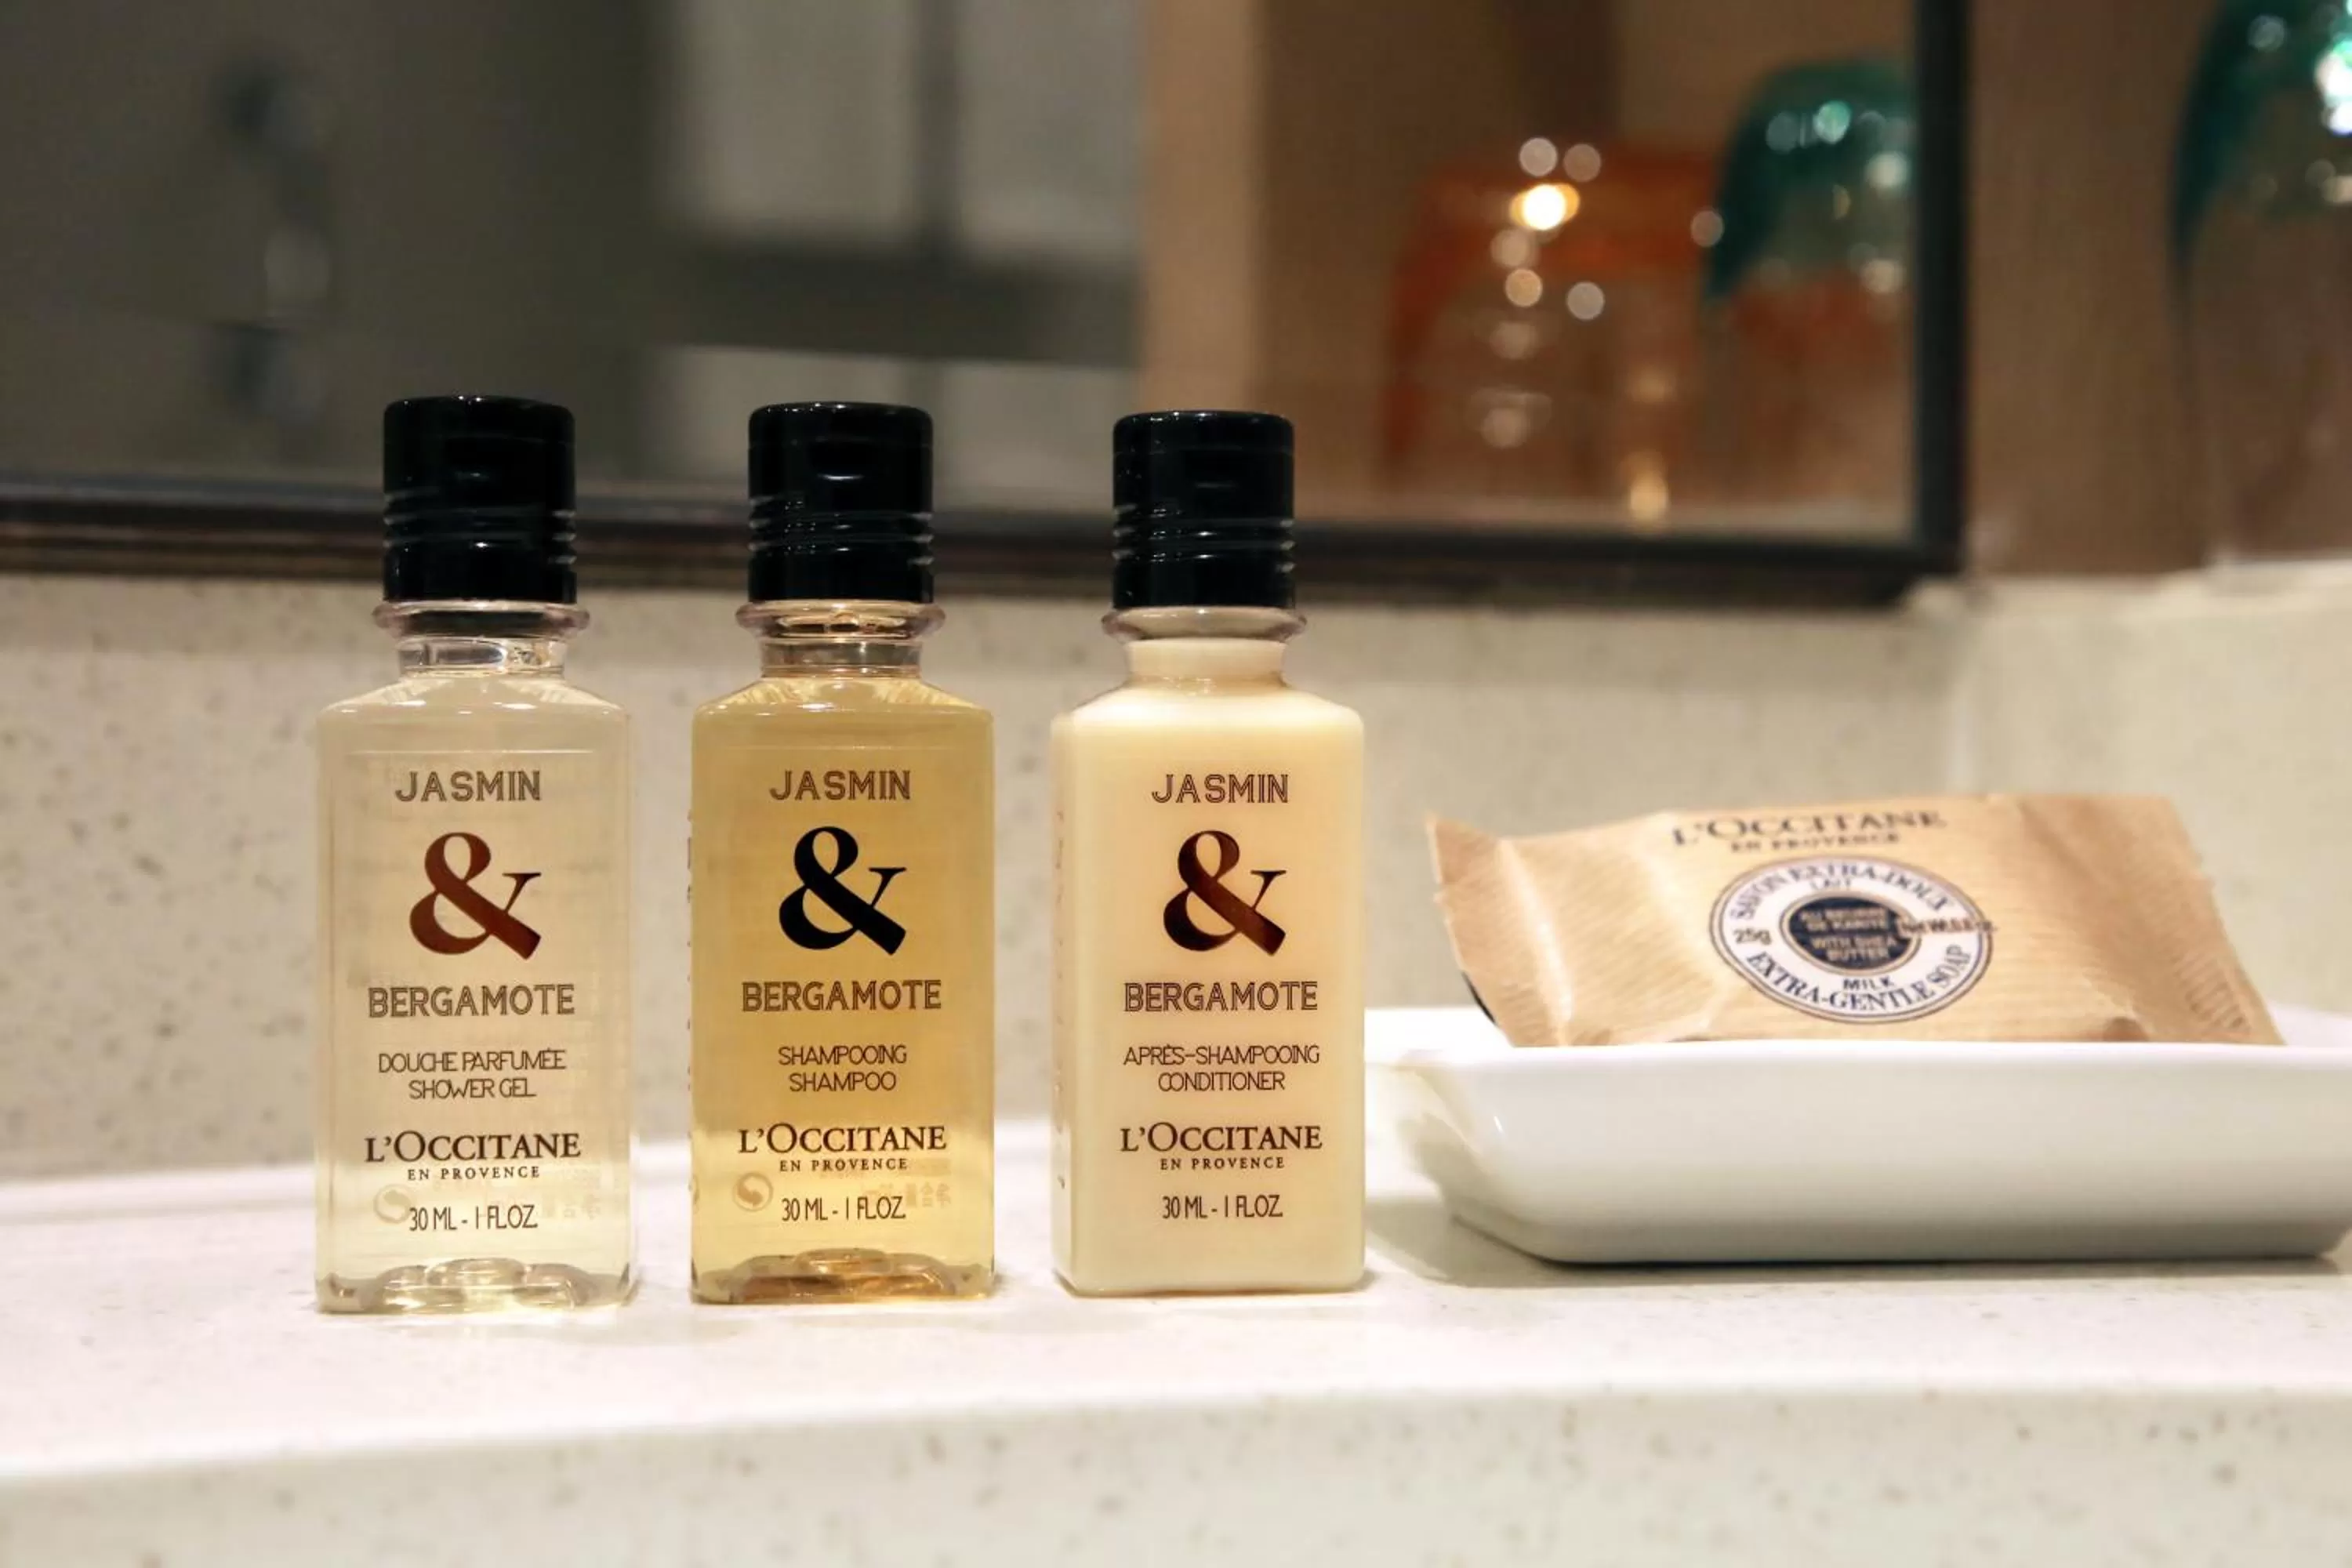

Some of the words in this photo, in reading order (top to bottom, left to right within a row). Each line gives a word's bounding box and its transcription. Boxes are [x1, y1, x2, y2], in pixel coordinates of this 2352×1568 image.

[395, 770, 543, 803] JASMIN
[769, 770, 911, 800] JASMIN
[1152, 773, 1289, 804] JASMIN
[409, 832, 542, 960] &
[778, 826, 907, 956] &
[1163, 829, 1287, 956] &
[742, 979, 942, 1012] BERGAMOTE
[1123, 981, 1319, 1012] BERGAMOTE
[1842, 975, 1895, 990] MILK
[368, 983, 575, 1018] BERGAMOTE
[378, 1051, 457, 1073] DOUCHE
[462, 1047, 568, 1071] PARFUMÉE
[778, 1044, 907, 1065] SHAMPOOING
[408, 1078, 495, 1099] SHOWER
[499, 1077, 537, 1098] GEL
[789, 1071, 896, 1092] SHAMPOO
[1158, 1071, 1286, 1092] CONDITIONER
[364, 1130, 582, 1163] L'OCCITANE
[738, 1123, 947, 1153] L'OCCITANE
[1120, 1122, 1323, 1152] L'OCCITANE
[408, 1169, 430, 1181] EN
[441, 1166, 540, 1180] PROVENCE
[779, 1160, 801, 1172] EN
[811, 1158, 908, 1171] PROVENCE
[1160, 1158, 1181, 1171] EN
[1191, 1156, 1285, 1170] PROVENCE
[409, 1207, 428, 1231] 30
[434, 1207, 457, 1231] ML
[782, 1198, 800, 1221] 30
[804, 1197, 829, 1221] ML
[1162, 1196, 1180, 1219] 30
[1185, 1196, 1208, 1219] ML
